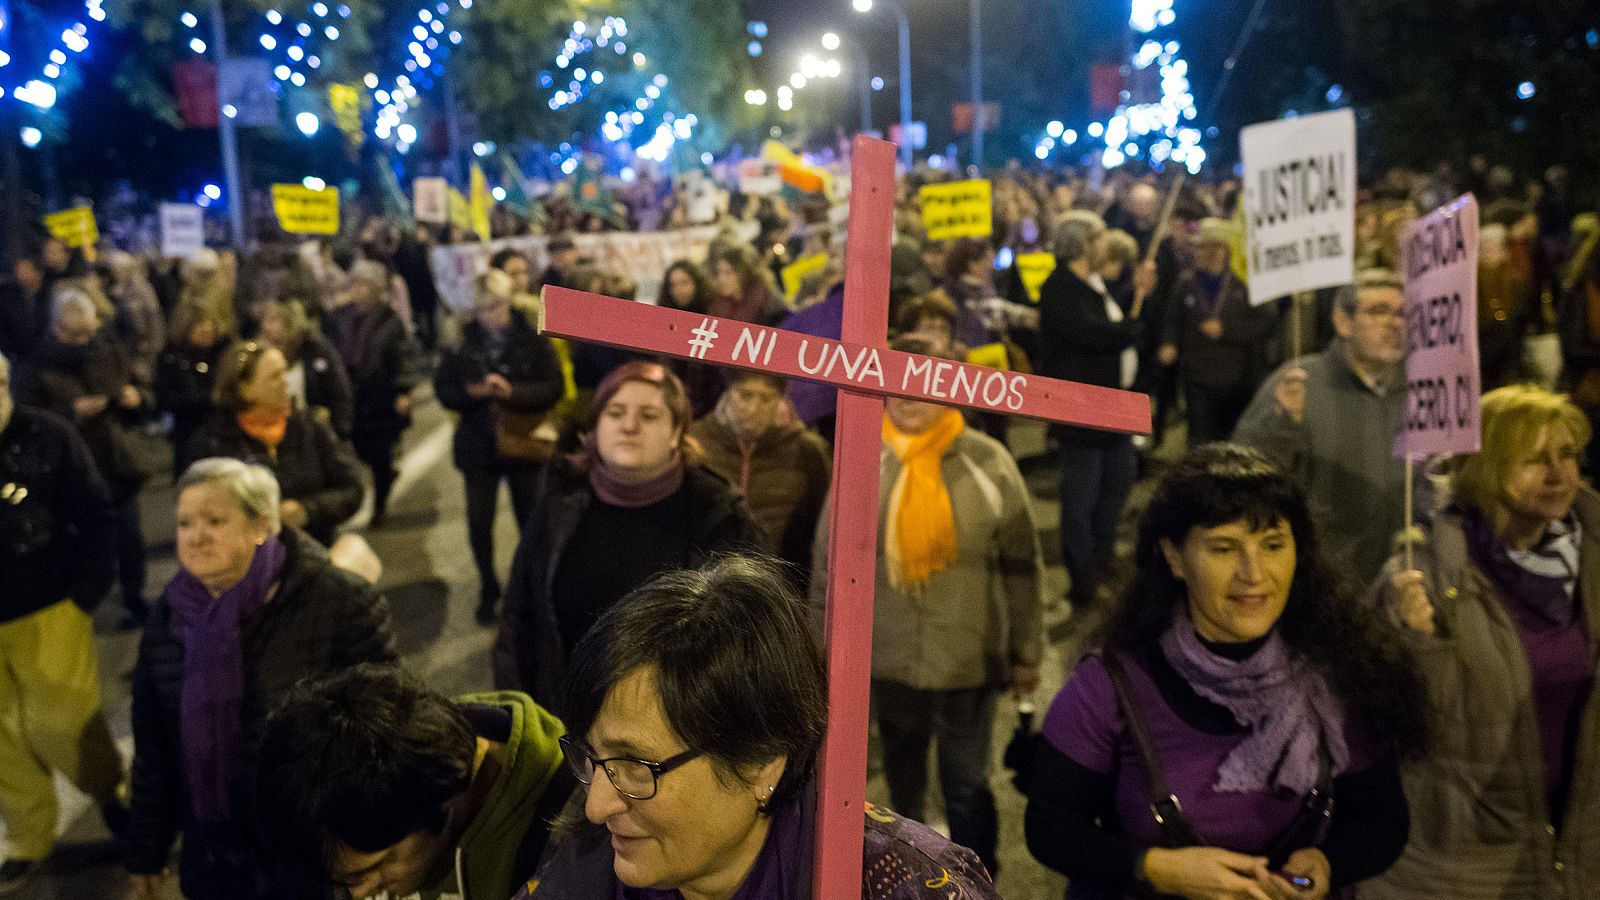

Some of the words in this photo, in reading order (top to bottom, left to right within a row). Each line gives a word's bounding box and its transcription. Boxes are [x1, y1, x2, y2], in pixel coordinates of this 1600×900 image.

[731, 327, 778, 366] NI
[798, 339, 885, 387] UNA
[902, 356, 1027, 410] MENOS
